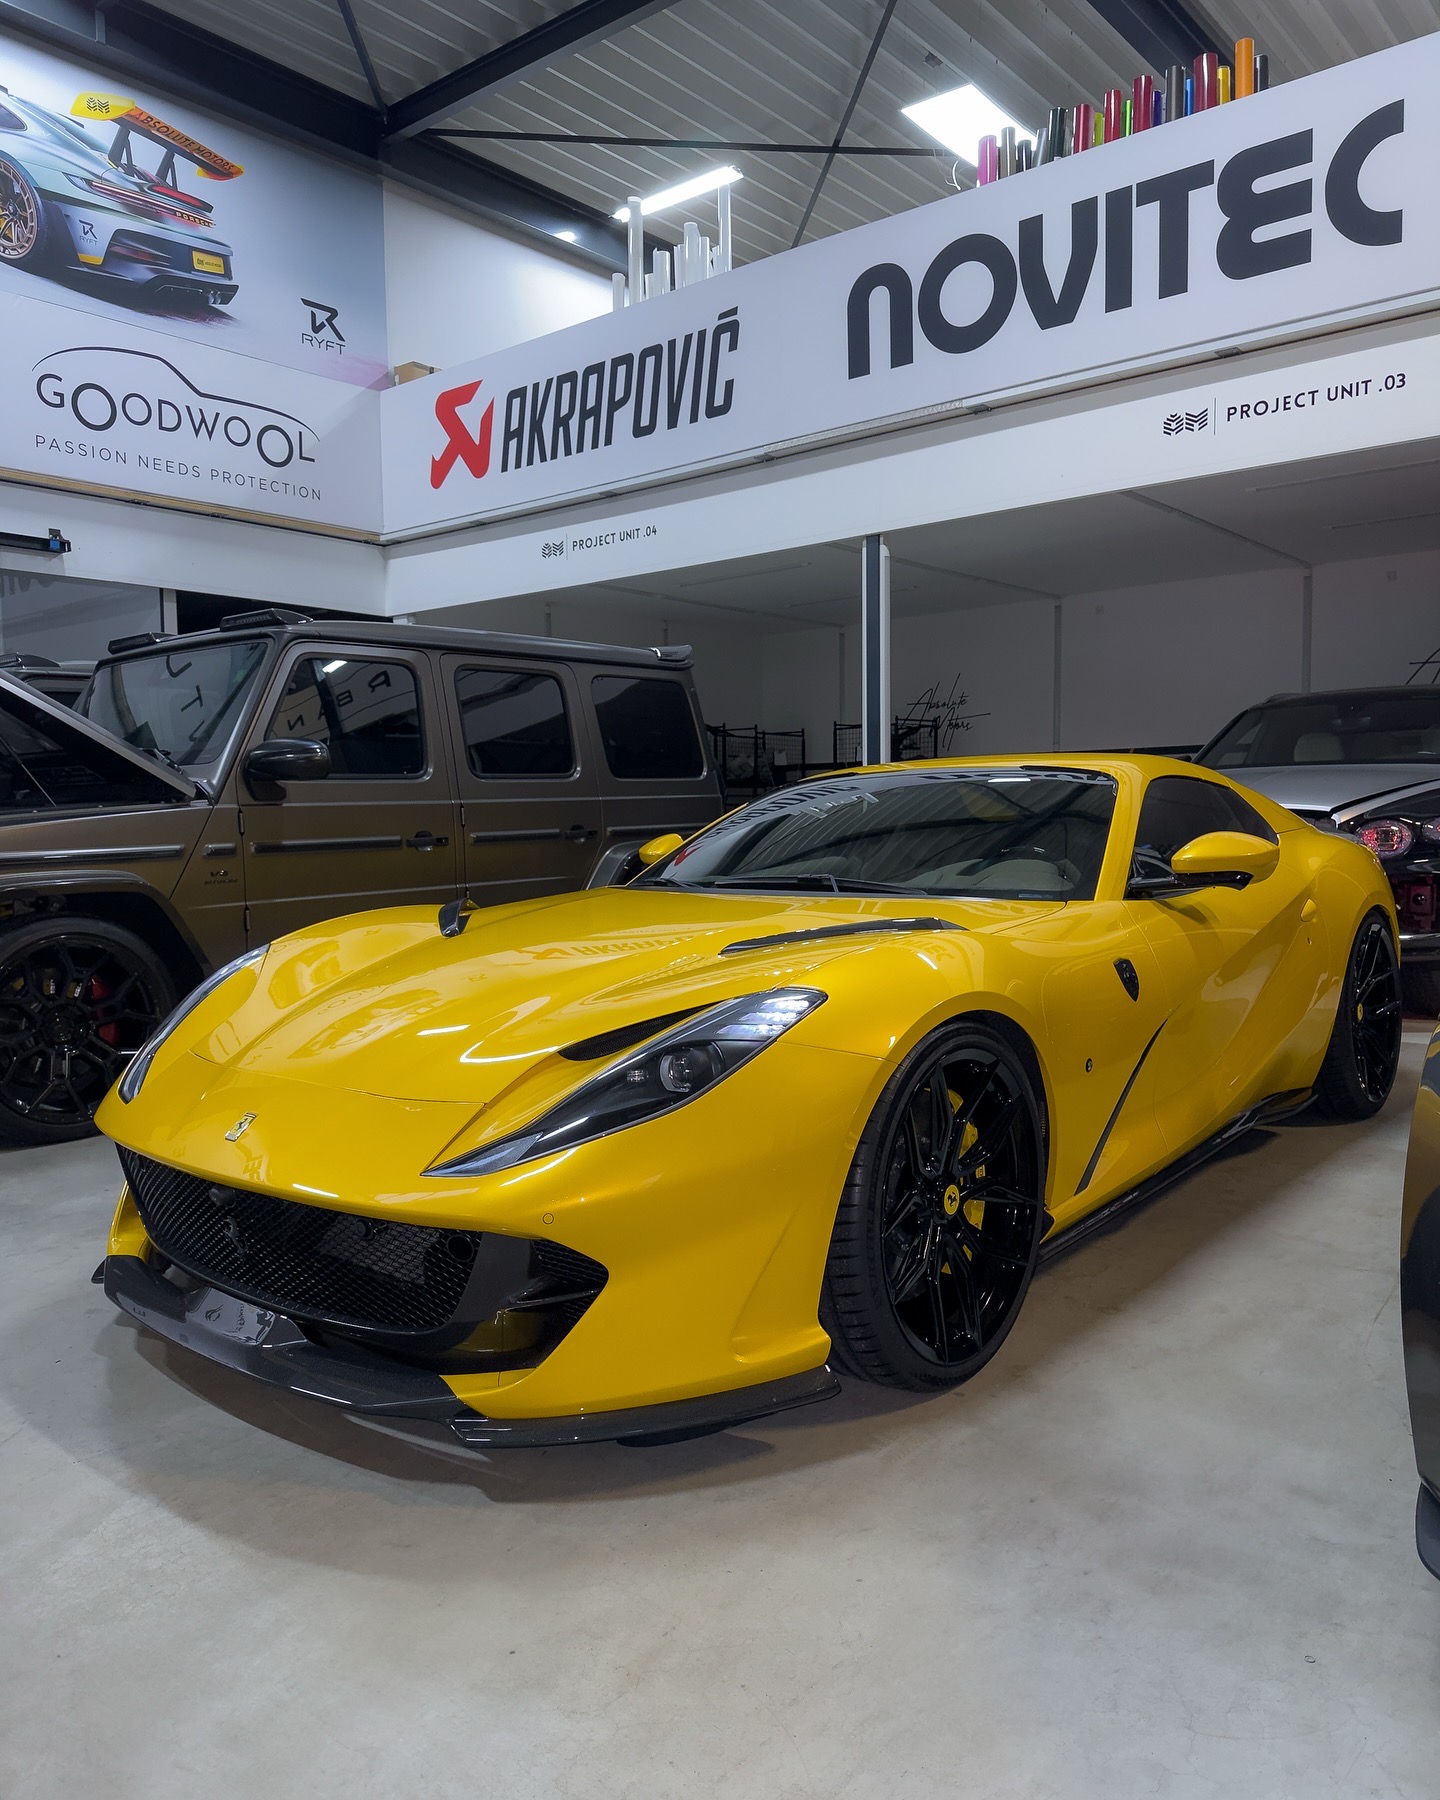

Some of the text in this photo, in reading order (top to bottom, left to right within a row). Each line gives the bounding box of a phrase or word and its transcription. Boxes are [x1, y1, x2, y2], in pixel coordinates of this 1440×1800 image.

[133, 111, 235, 171] ABSOLUTE MOTORS
[847, 98, 1405, 379] NOVITEC
[301, 332, 346, 355] RYFT
[36, 373, 316, 468] GOODWOOL
[1226, 373, 1406, 422] PROJECT UNIT .03
[35, 434, 322, 501] PASSION NEEDS PROTECTION
[572, 533, 616, 551] PROJECT
[619, 528, 641, 542] UNIT
